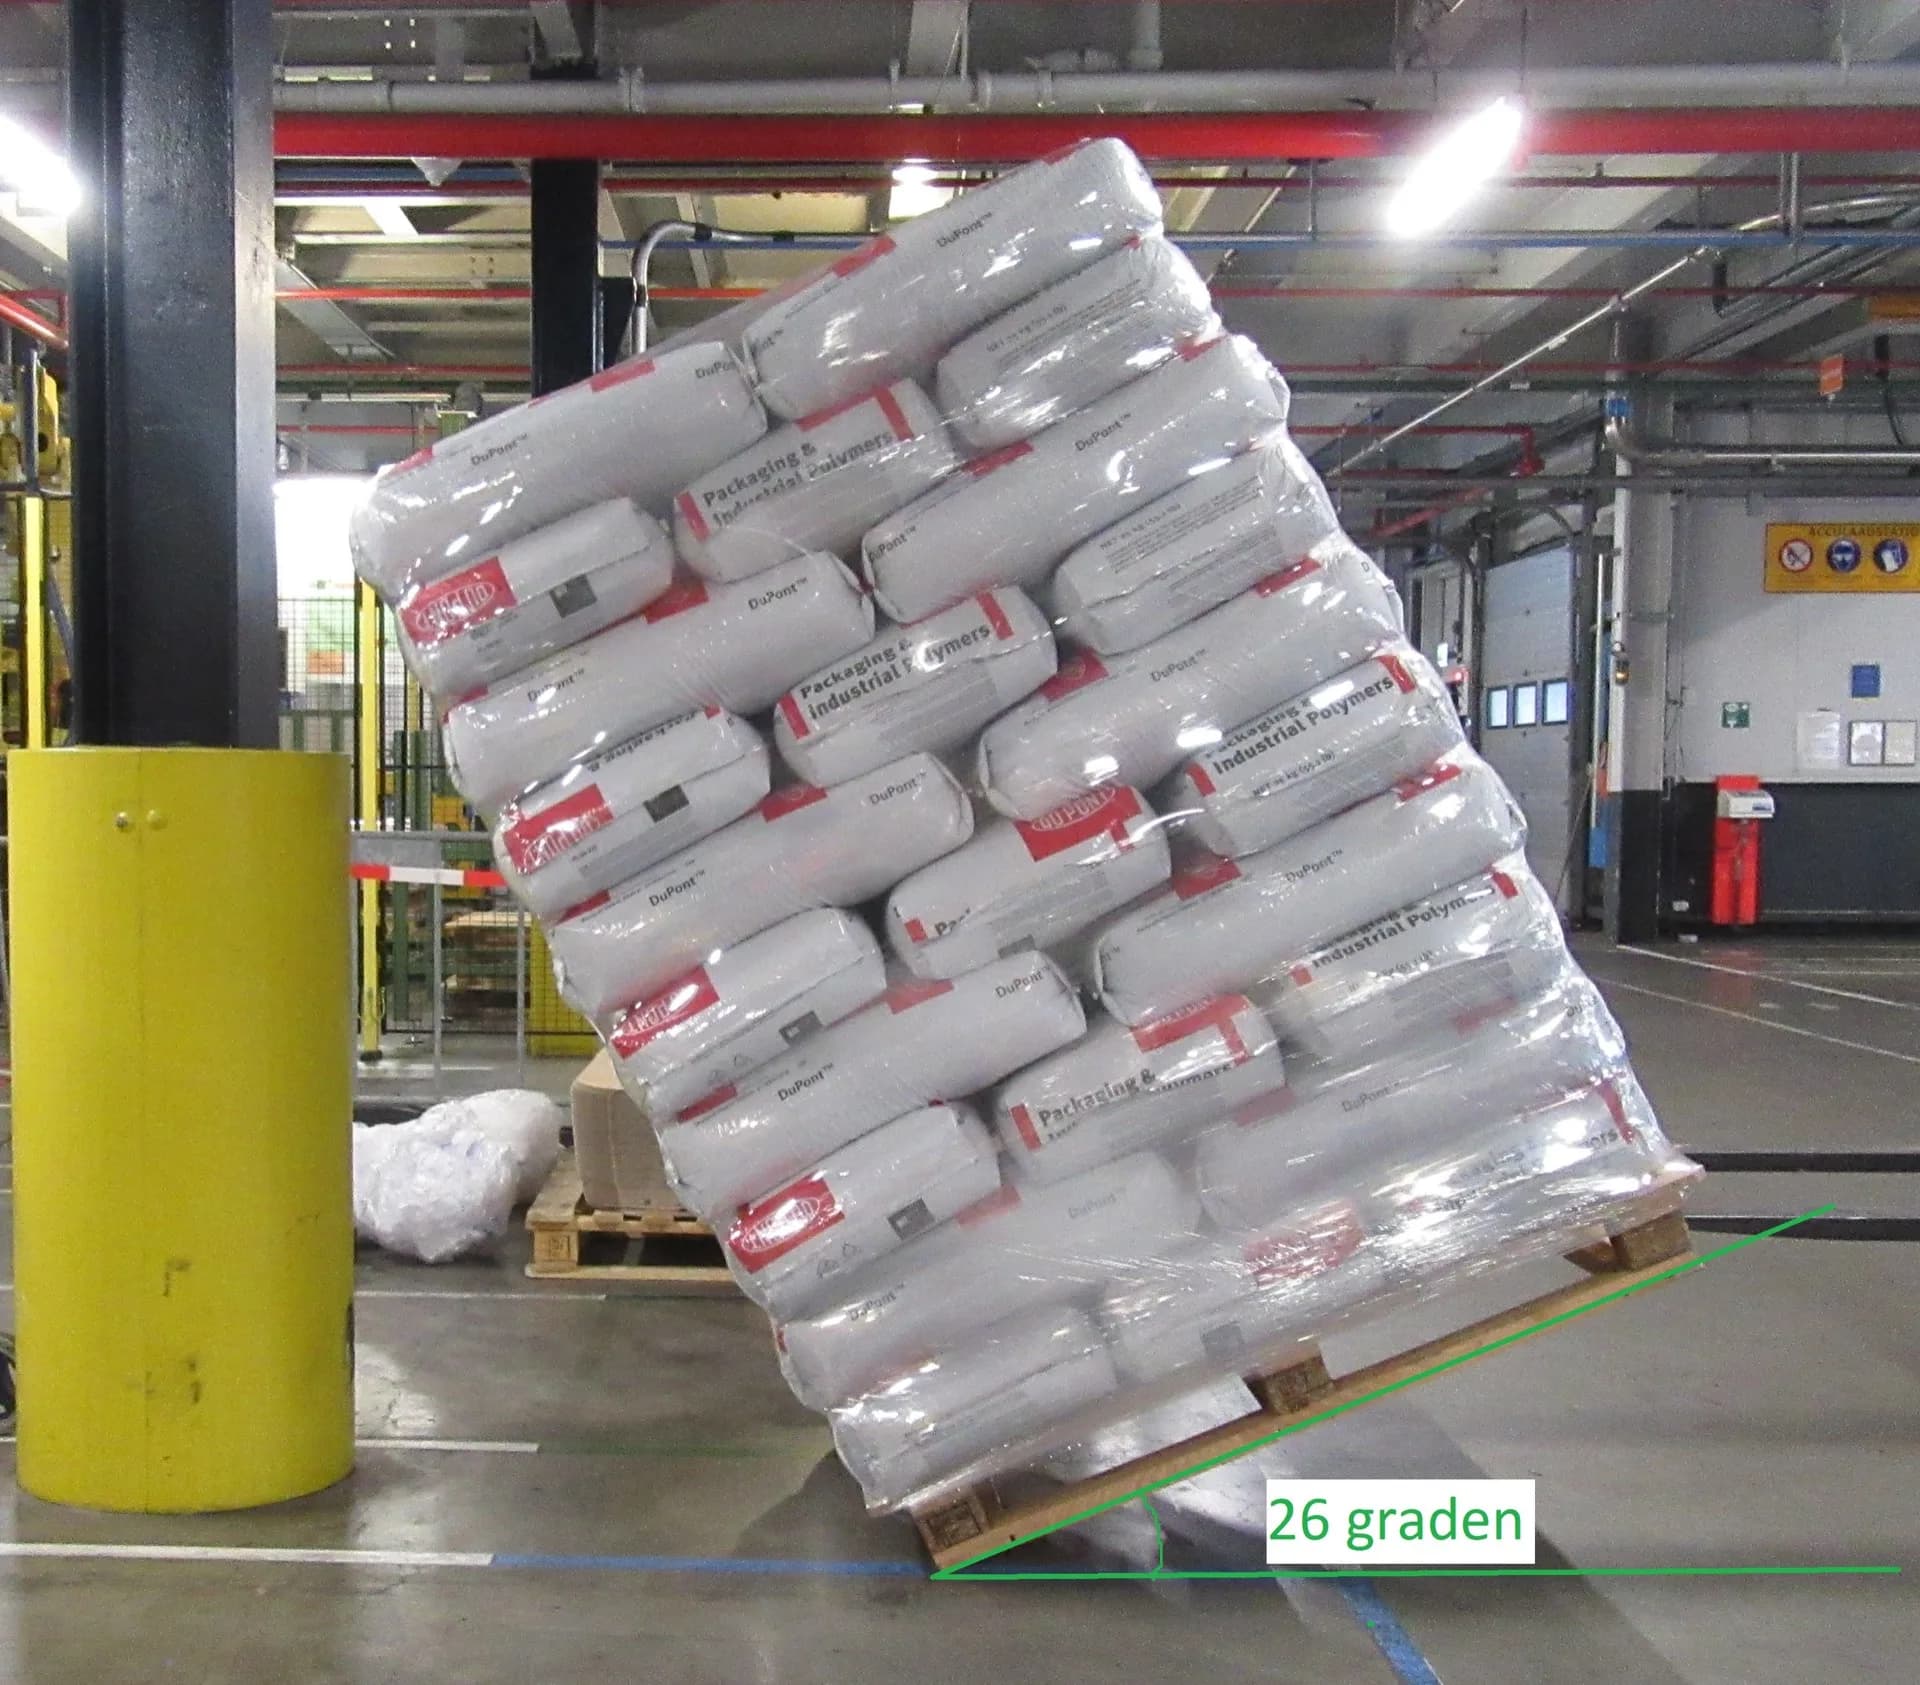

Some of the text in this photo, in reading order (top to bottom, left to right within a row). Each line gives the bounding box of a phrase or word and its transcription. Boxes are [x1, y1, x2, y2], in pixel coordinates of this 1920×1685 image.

[702, 442, 817, 507] Packaging &
[800, 648, 897, 700] Packaging
[807, 663, 902, 720] Industrial
[1212, 676, 1394, 775] Industrial Polymers
[1311, 920, 1406, 969] Industrial
[1038, 1076, 1142, 1128] Packaging
